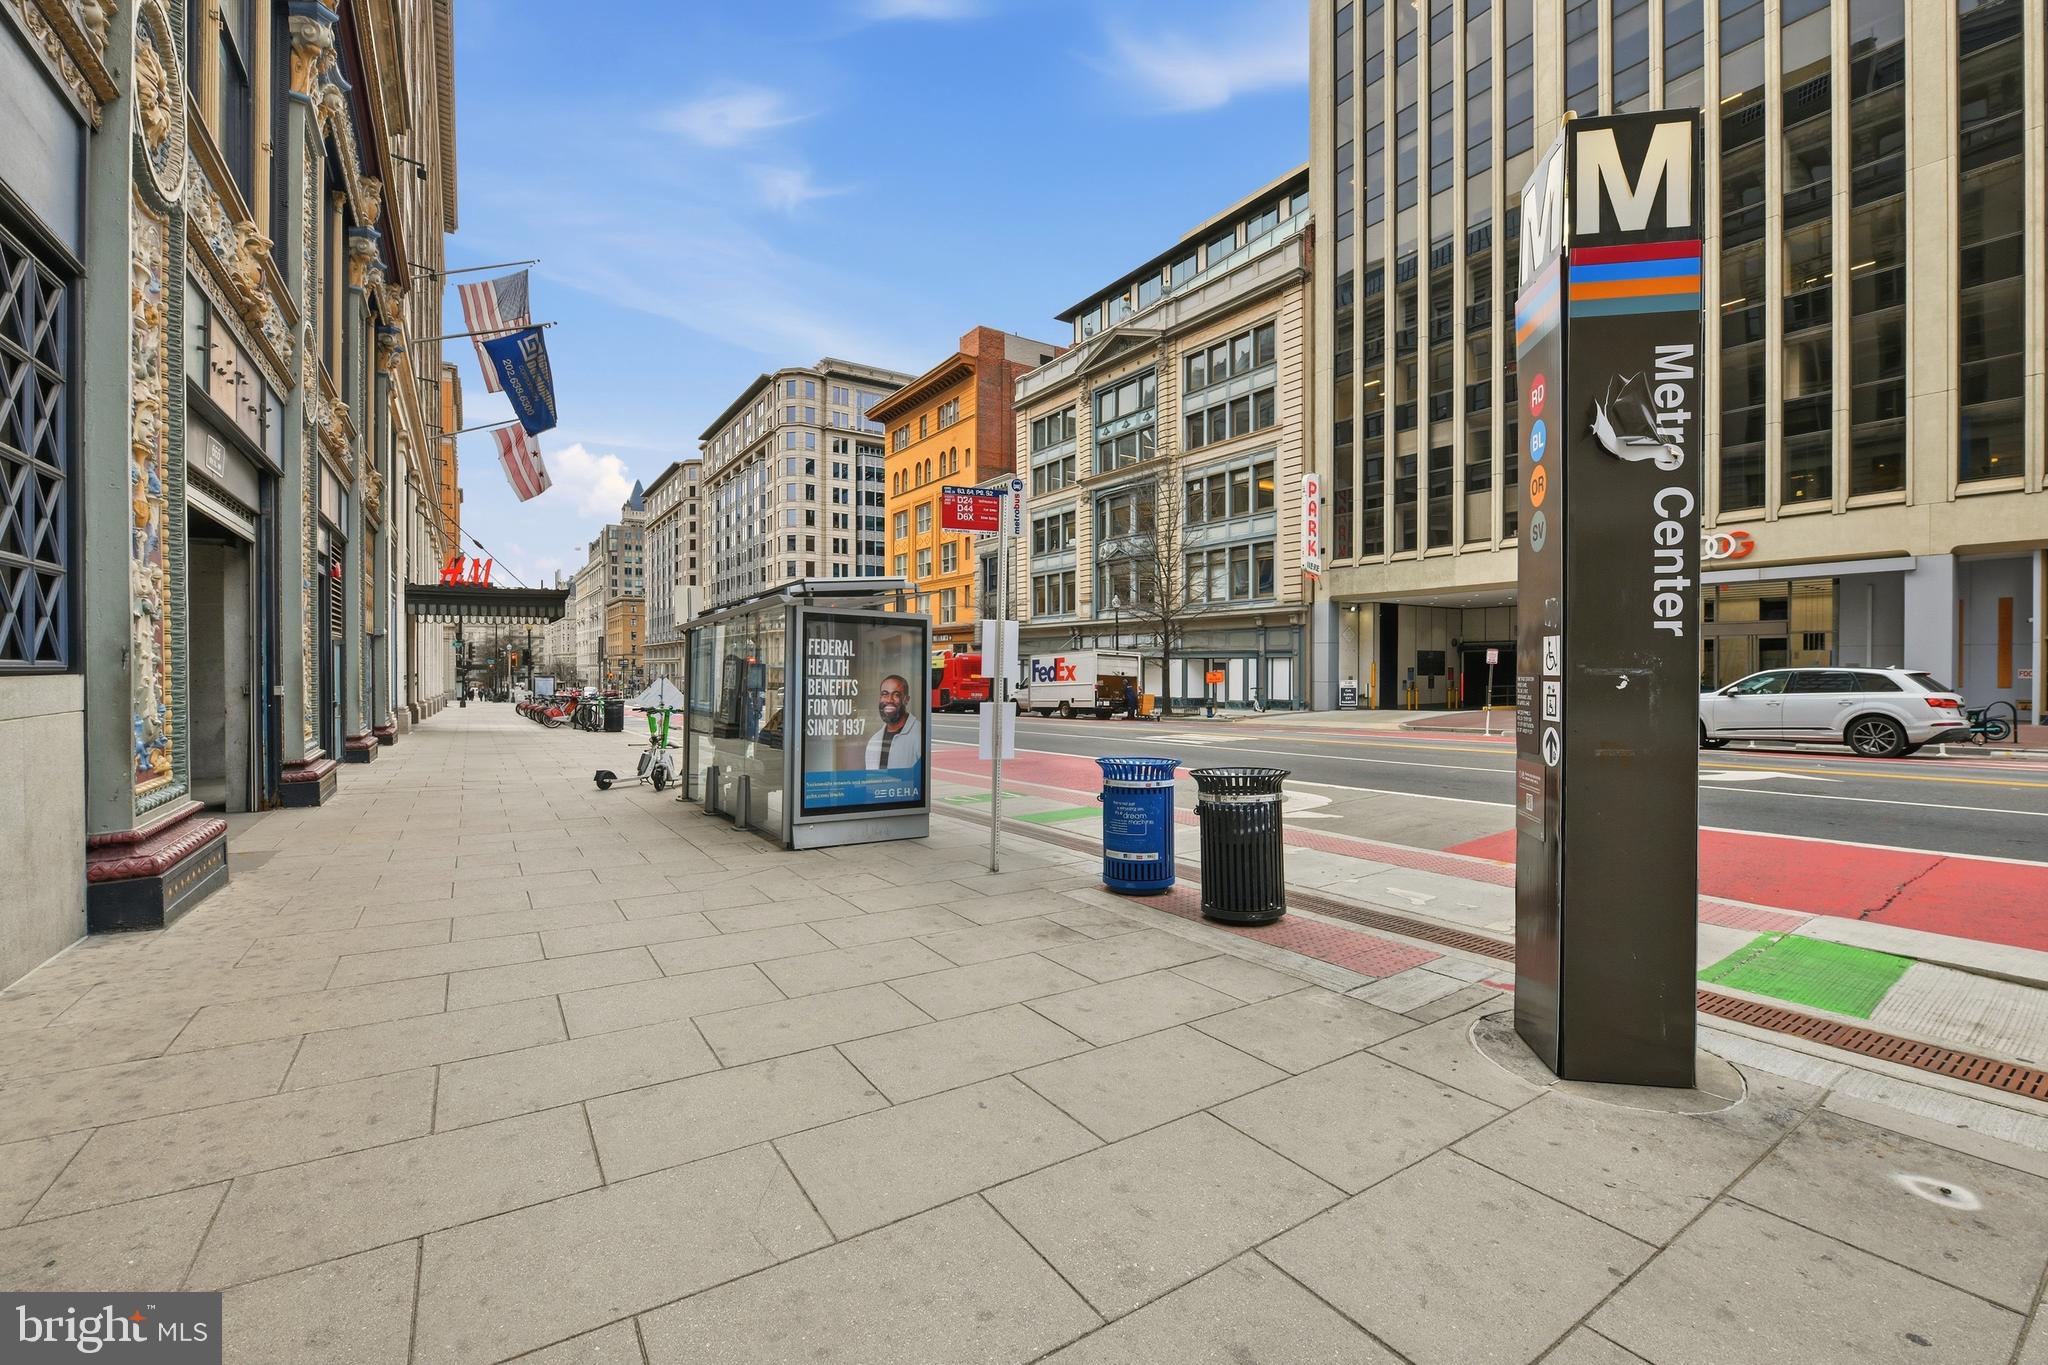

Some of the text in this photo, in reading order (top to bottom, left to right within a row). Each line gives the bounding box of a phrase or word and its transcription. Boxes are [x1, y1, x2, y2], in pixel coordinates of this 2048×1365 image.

[1576, 120, 1692, 235] M
[1521, 143, 1562, 287] M
[1531, 384, 1544, 408] RD
[1532, 434, 1544, 451] BL
[1531, 475, 1544, 496] OR
[1652, 344, 1695, 637] Metro Center
[957, 496, 973, 504] D24
[957, 504, 973, 512] D44
[957, 513, 974, 521] D6X
[1308, 482, 1317, 556] PARK
[1532, 522, 1544, 541] SV
[808, 639, 855, 656] FEDERAL
[808, 659, 850, 676] HEALTH
[1032, 657, 1076, 682] FedEx
[807, 679, 858, 696] BENEFITS
[807, 699, 853, 716] FOR YOU
[807, 719, 866, 736] SINCE 1937
[1123, 812, 1148, 820] dream
